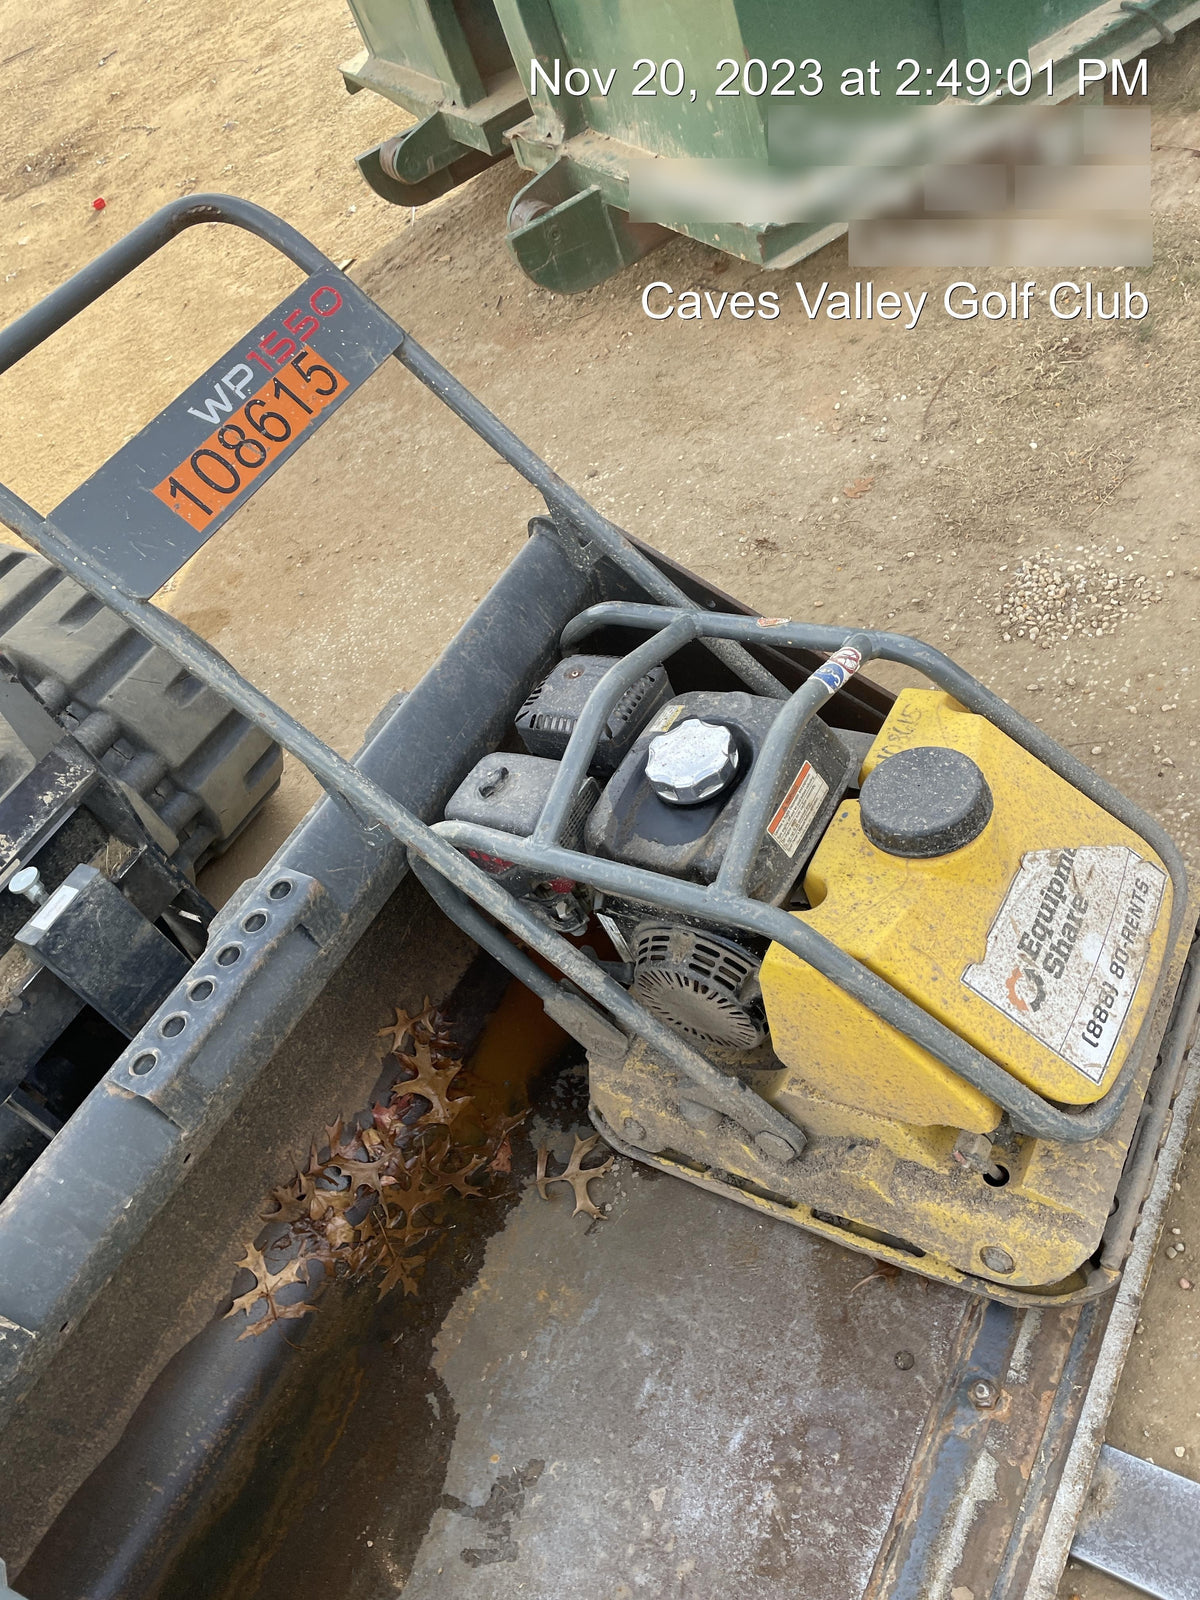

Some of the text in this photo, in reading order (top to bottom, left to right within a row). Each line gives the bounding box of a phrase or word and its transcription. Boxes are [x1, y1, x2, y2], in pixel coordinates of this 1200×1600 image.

[187, 285, 344, 425] WP1550
[168, 350, 339, 516] 108615
[1042, 895, 1090, 980] Share
[1081, 876, 1150, 1048] (888) 80-RENTS
